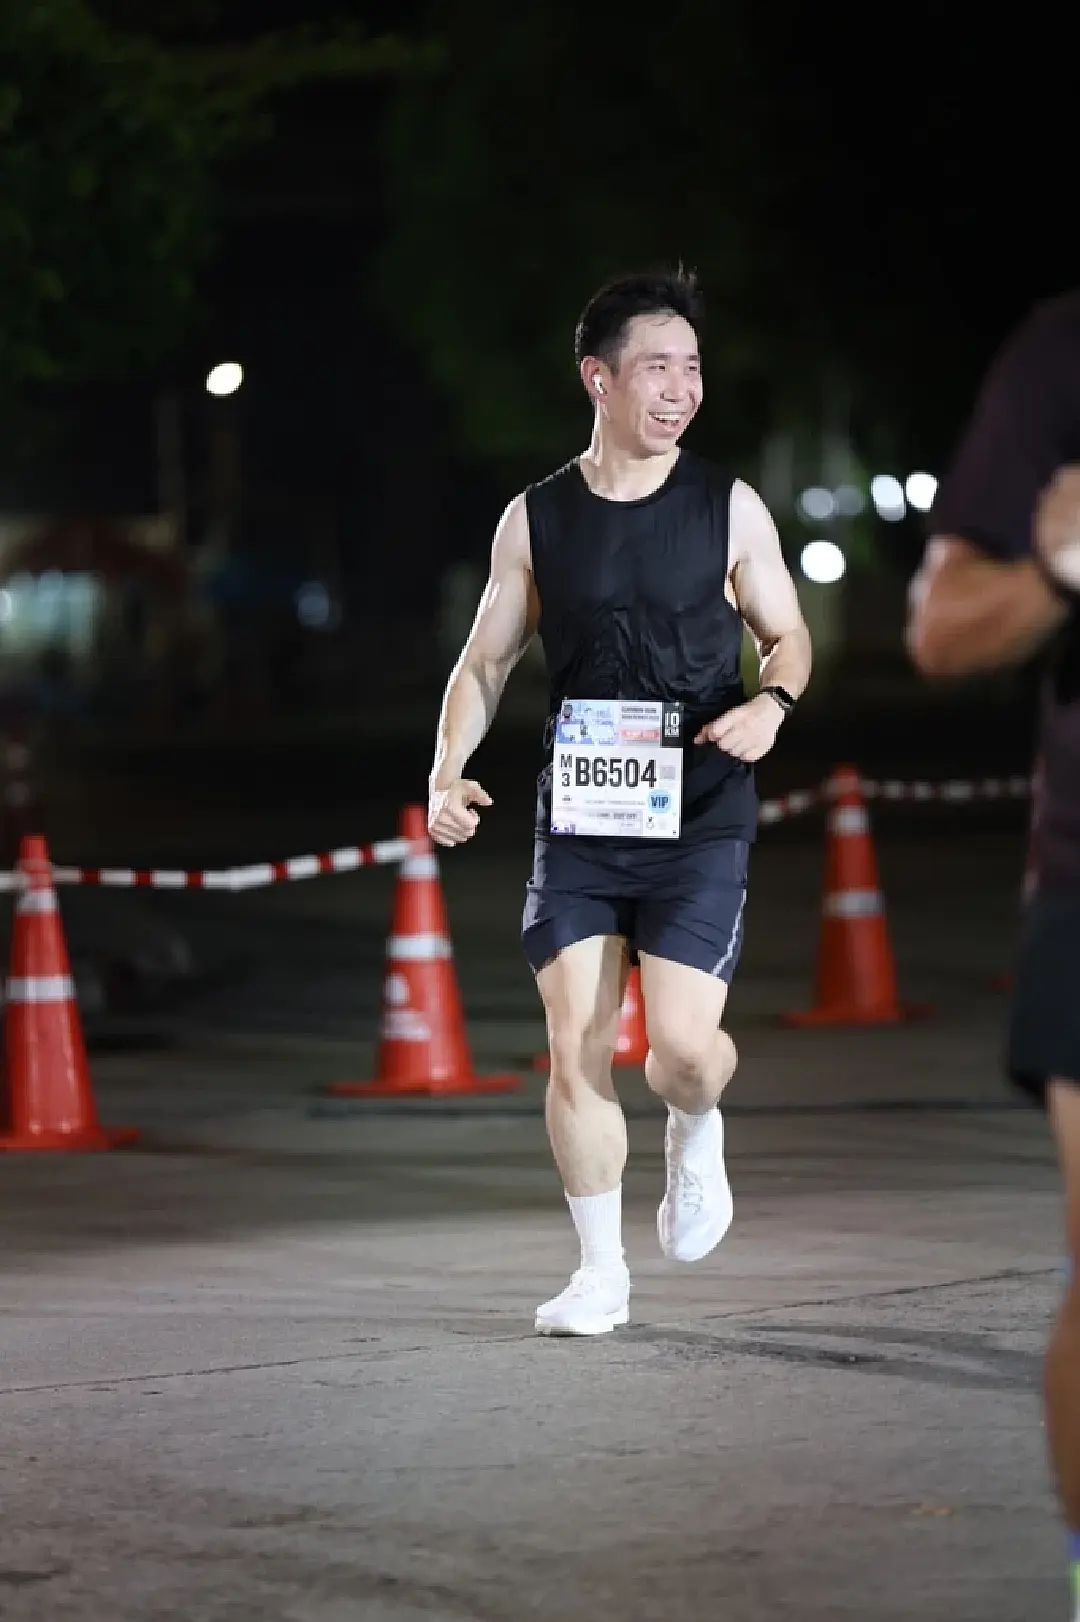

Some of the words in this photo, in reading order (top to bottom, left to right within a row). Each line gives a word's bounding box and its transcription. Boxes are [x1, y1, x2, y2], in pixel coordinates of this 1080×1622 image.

[665, 713, 679, 725] 10
[561, 754, 572, 768] M
[575, 757, 657, 788] B6504
[562, 773, 570, 787] 3
[651, 796, 669, 808] VIP
